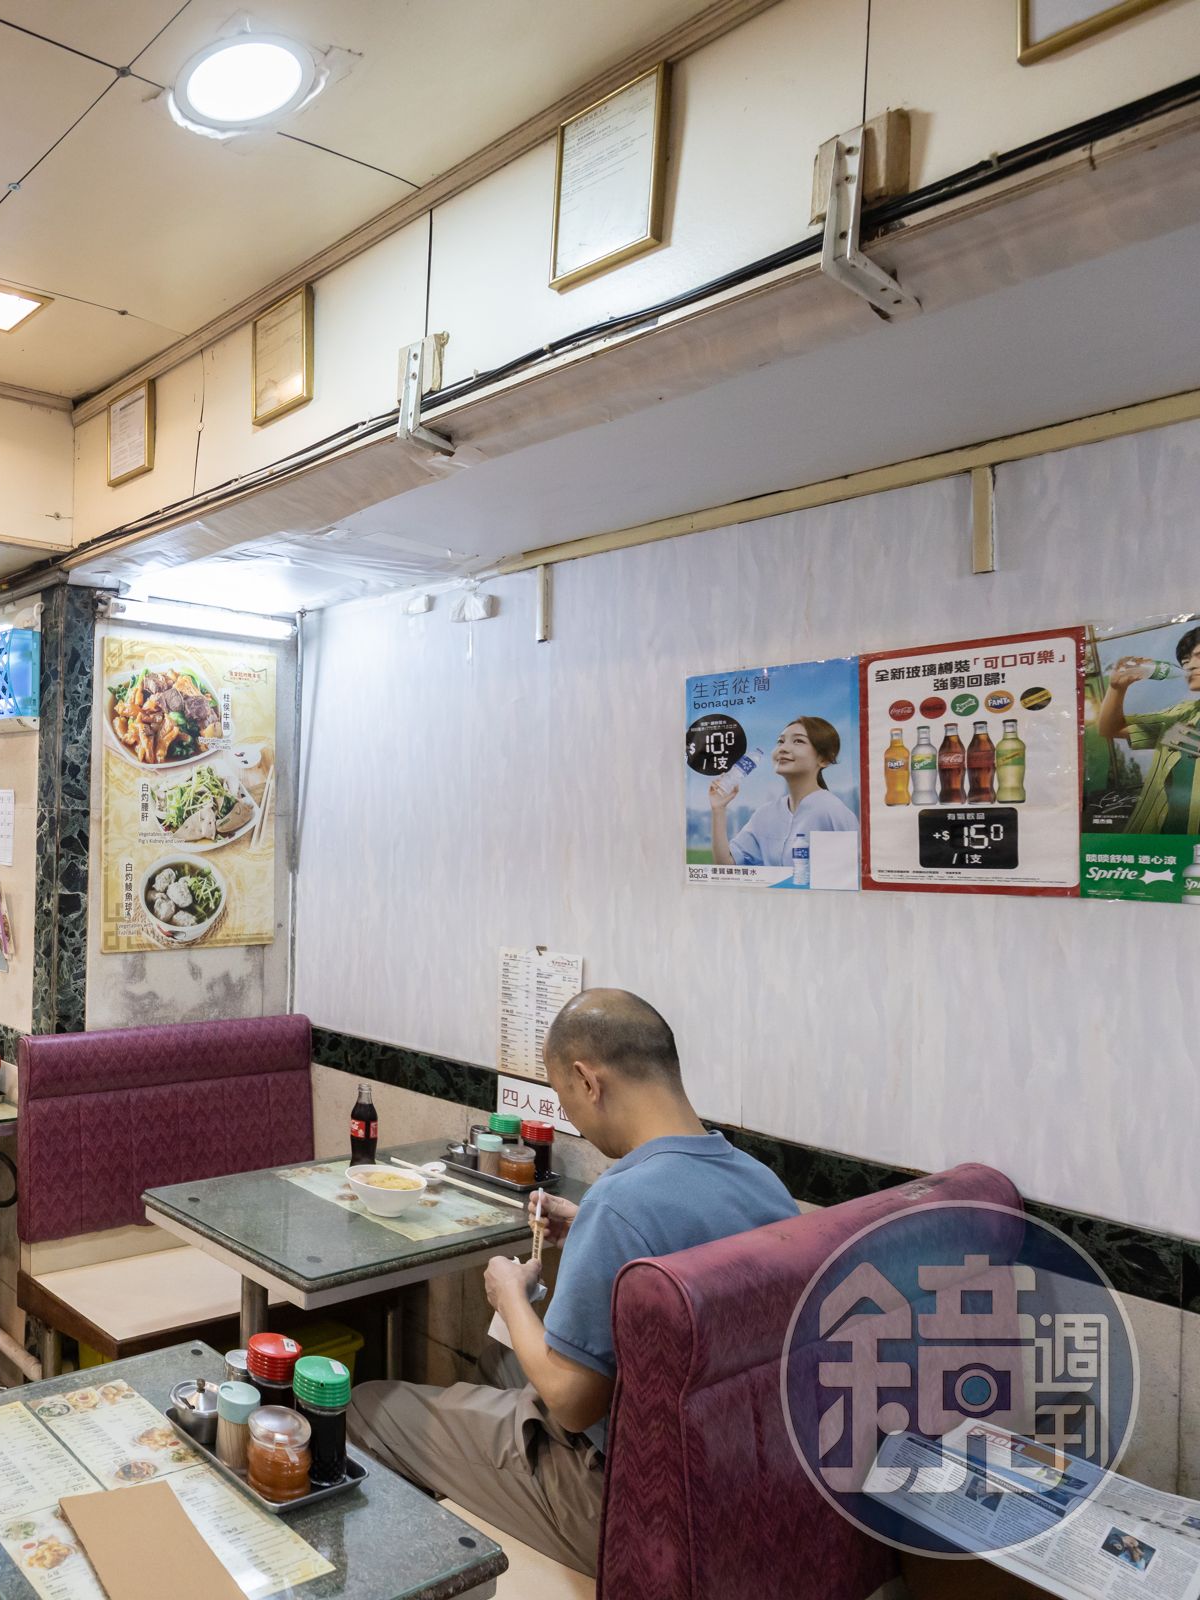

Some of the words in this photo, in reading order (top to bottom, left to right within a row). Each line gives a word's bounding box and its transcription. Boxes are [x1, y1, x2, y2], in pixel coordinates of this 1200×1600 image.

[692, 676, 770, 699] 生活從簡
[933, 673, 1006, 692] 強勢回歸!
[693, 698, 744, 710] bonaqua
[1085, 866, 1138, 881] Sprite
